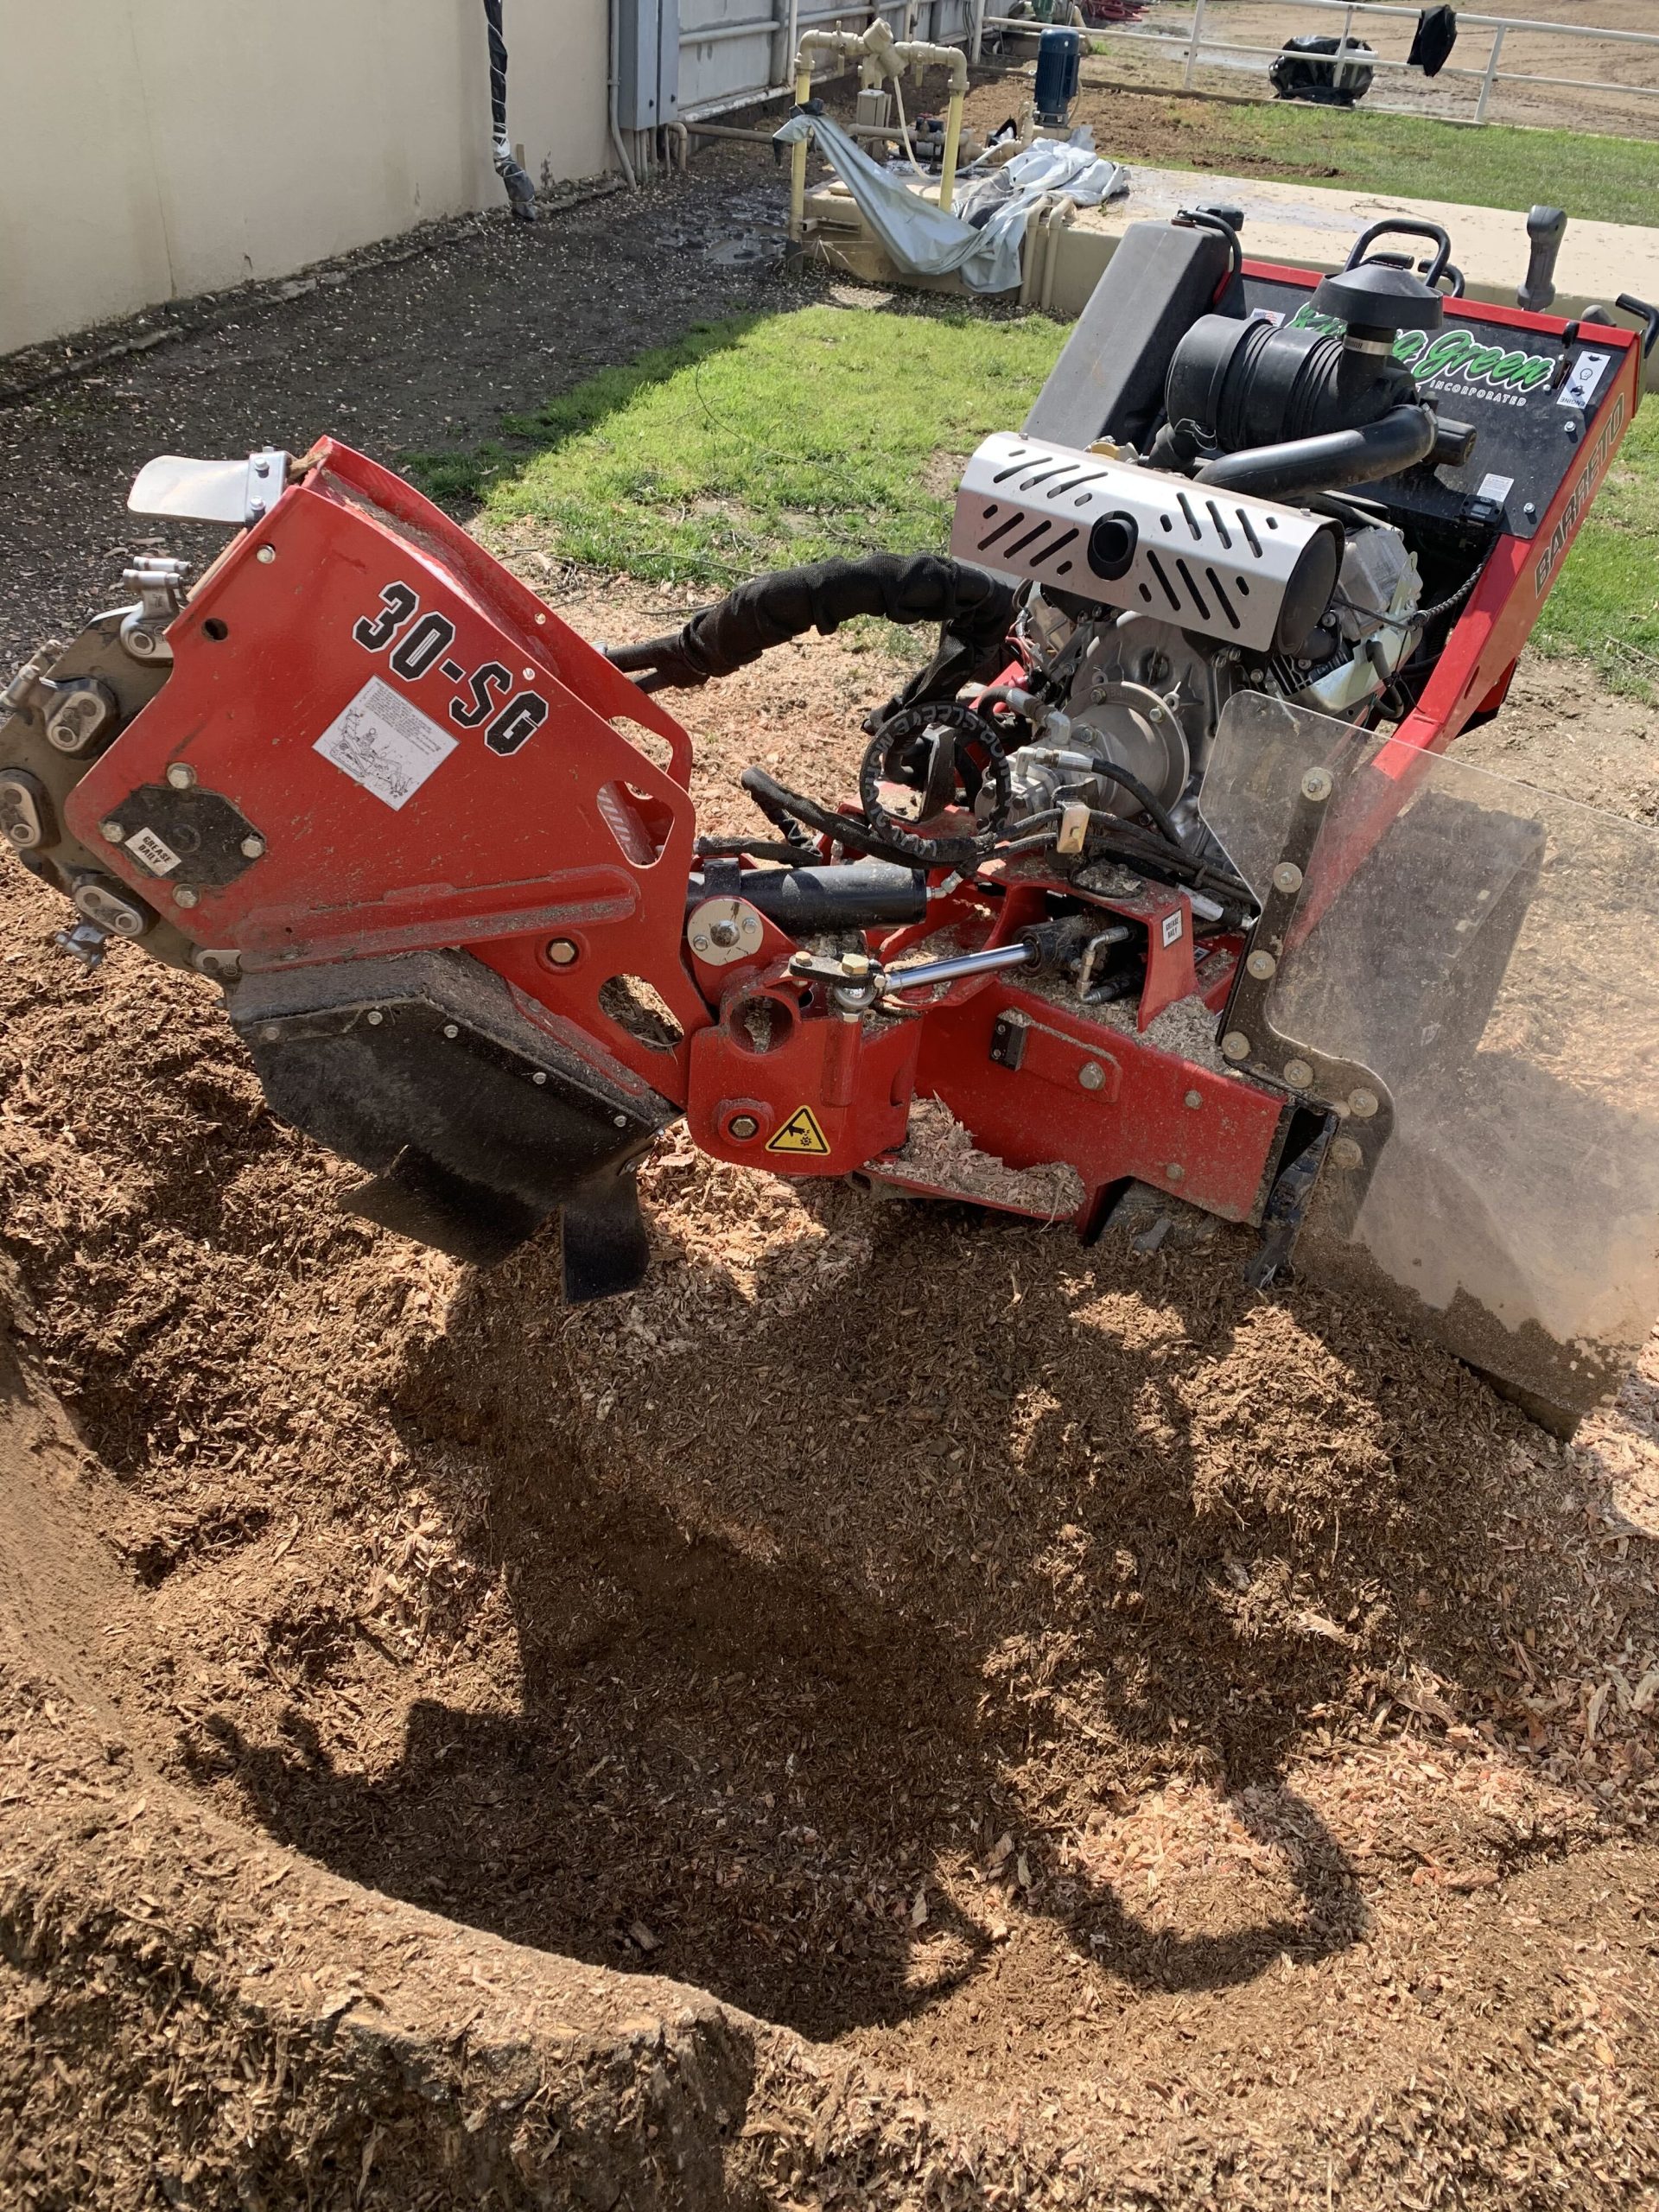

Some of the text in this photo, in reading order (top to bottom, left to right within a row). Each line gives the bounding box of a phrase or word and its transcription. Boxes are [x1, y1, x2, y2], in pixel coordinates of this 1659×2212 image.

[1410, 329, 1555, 392] Green
[1429, 379, 1528, 407] INCORPORATED
[1560, 397, 1586, 407] ENGINE
[1535, 392, 1624, 599] BARRETO
[352, 580, 549, 756] 30-SG
[894, 704, 980, 734] SLEEVE
[137, 844, 162, 864] DAILY
[142, 836, 173, 863] GREASE
